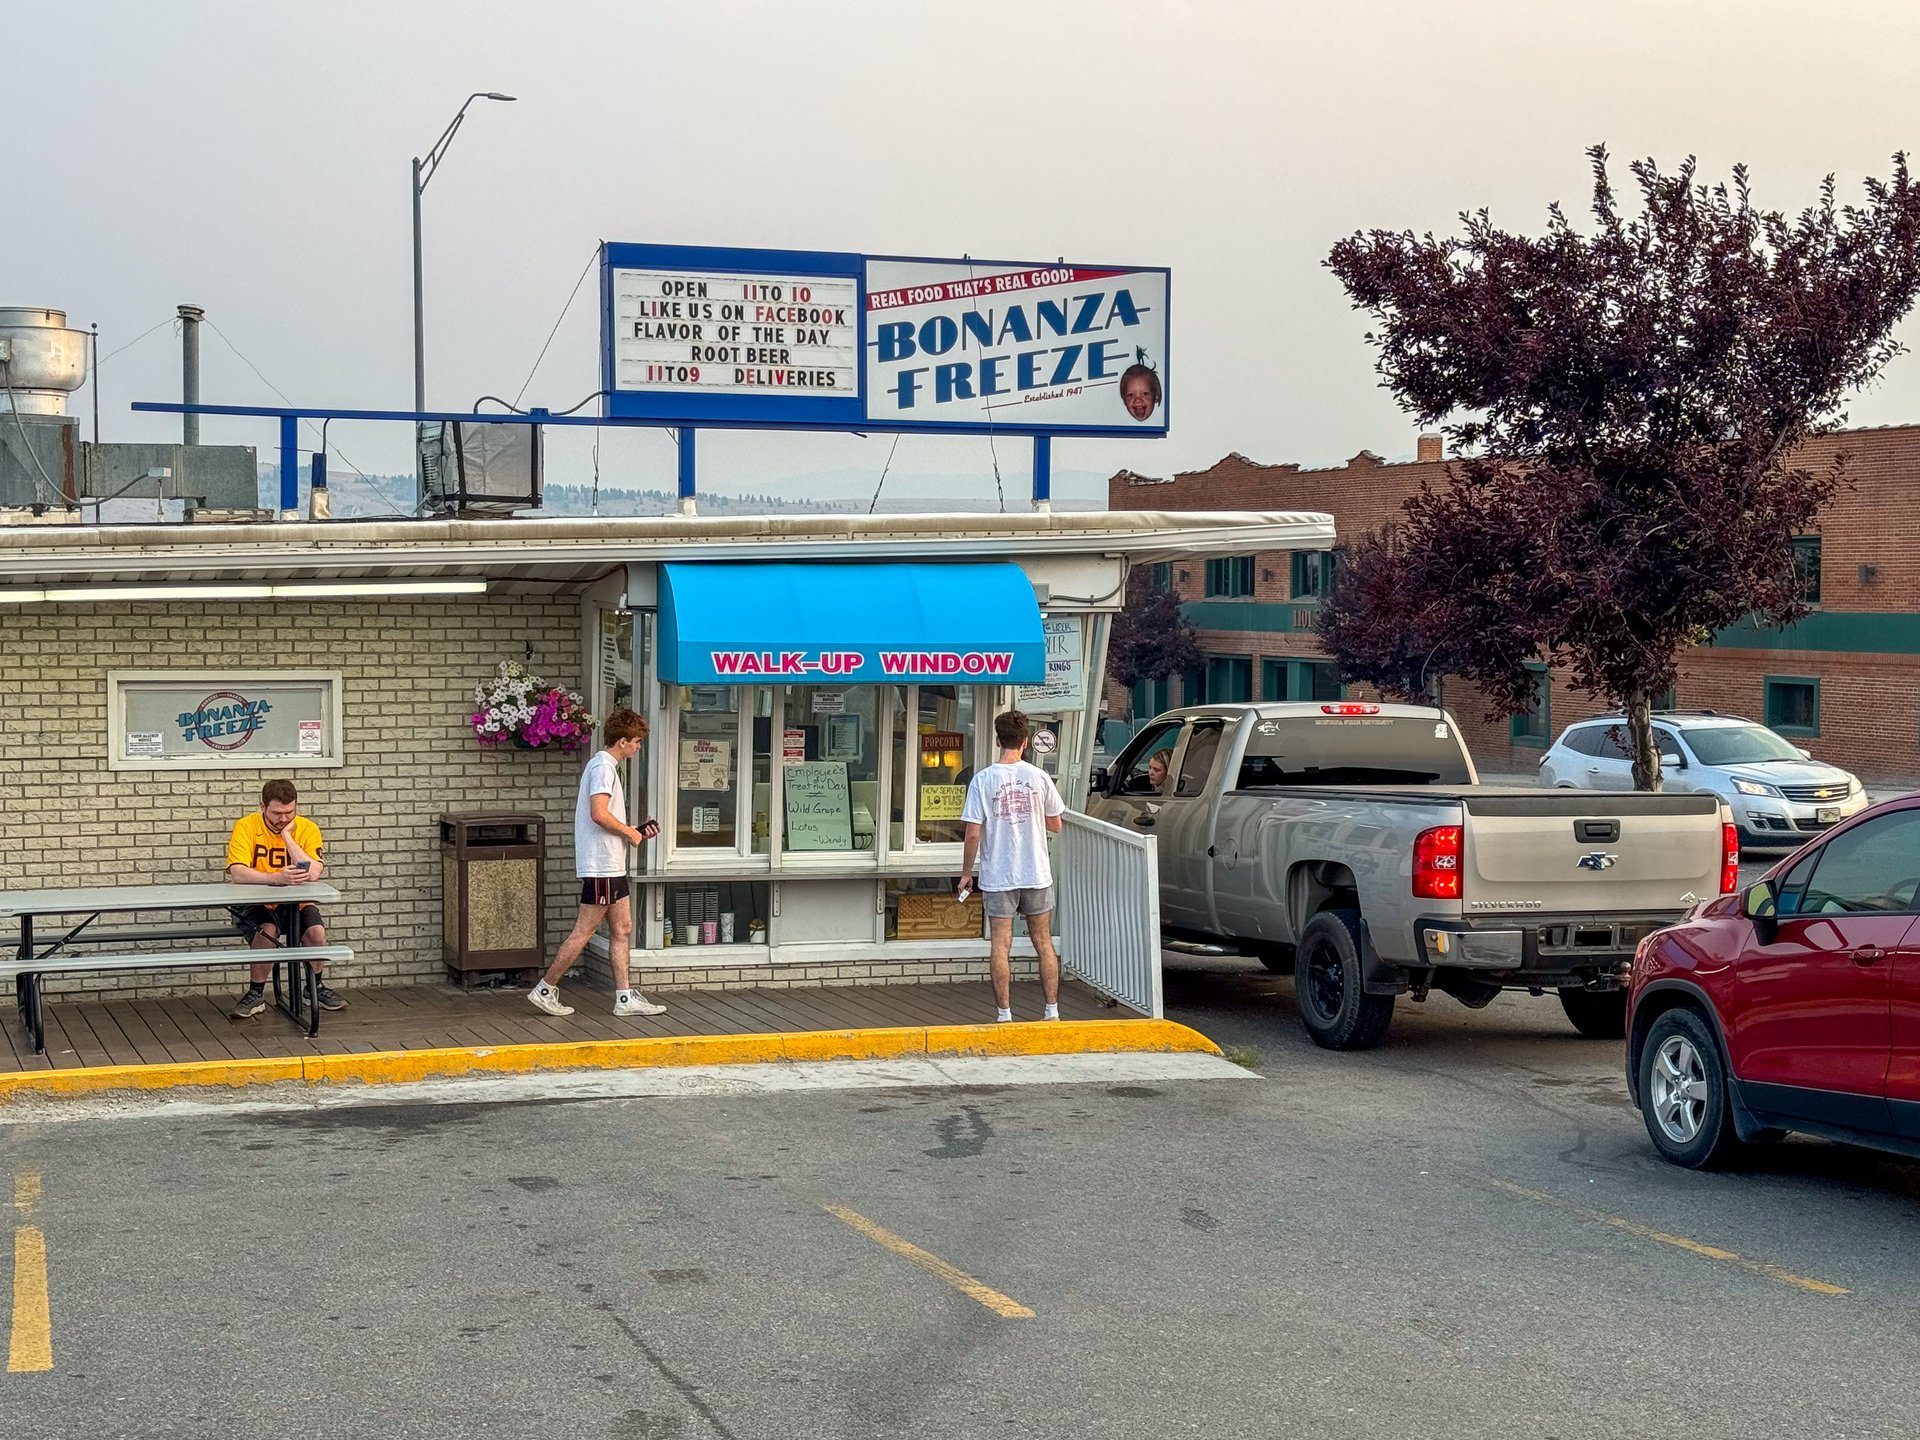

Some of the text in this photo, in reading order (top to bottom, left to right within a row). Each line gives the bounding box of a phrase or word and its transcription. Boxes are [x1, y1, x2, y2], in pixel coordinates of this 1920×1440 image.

[661, 280, 708, 298] OPEN
[870, 268, 1075, 309] REAL FOOD THAT'S REAL GOOD!
[640, 300, 845, 325] LIKE US ON FACEBOOK
[634, 322, 830, 345] FLAVOR OF THE DAY
[867, 288, 1151, 363] BONANZA
[691, 345, 790, 364] ROOT BEER
[734, 368, 836, 386] DELIVERIES
[887, 338, 1130, 410] FREEZE
[1023, 386, 1083, 404] Established 1947
[710, 651, 1015, 675] WALK-UP WINDOW
[1049, 661, 1071, 672] RINGS
[175, 699, 273, 728] BONANZA
[182, 714, 267, 742] FREEZE
[924, 736, 961, 748] POPCORN
[786, 779, 812, 791] Treat
[827, 778, 847, 800] Day
[922, 786, 965, 795] NOW SERVING
[788, 802, 841, 817] Wild Grape
[927, 795, 962, 807] LOTUS
[791, 820, 819, 832] Lotus
[1471, 900, 1542, 909] SILVERADO
